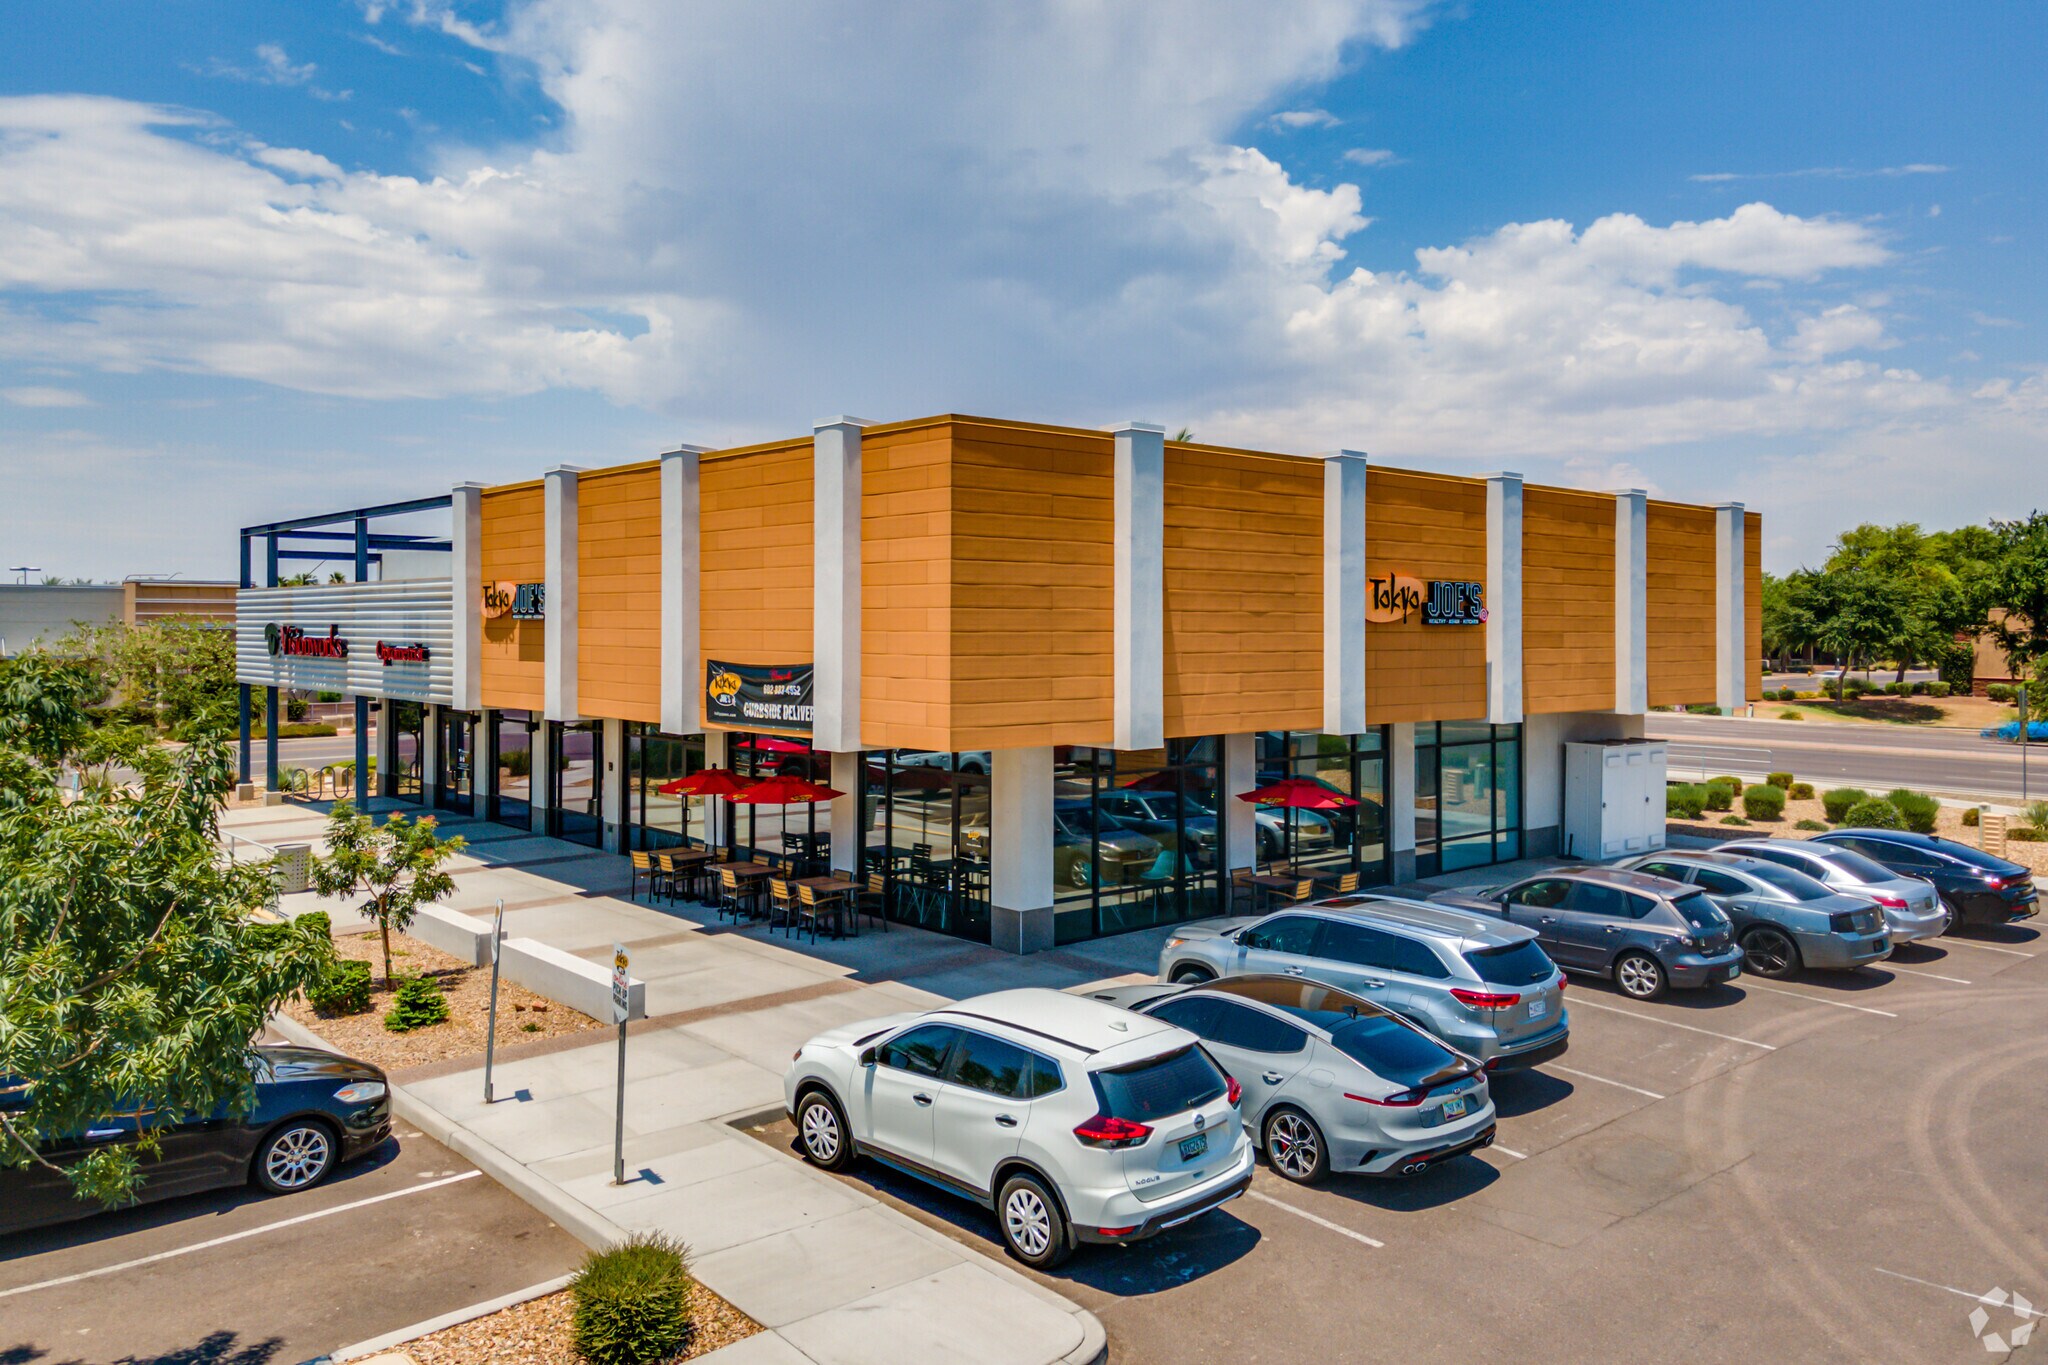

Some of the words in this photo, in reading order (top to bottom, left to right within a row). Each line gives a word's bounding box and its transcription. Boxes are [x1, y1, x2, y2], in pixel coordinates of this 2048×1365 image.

[482, 580, 509, 618] Tokyo
[512, 584, 545, 613] JOE'S
[1369, 572, 1419, 624] Tokyo
[1428, 582, 1482, 617] JOE'S
[280, 624, 349, 658] Visionworks
[744, 702, 781, 719] CURBSIDE
